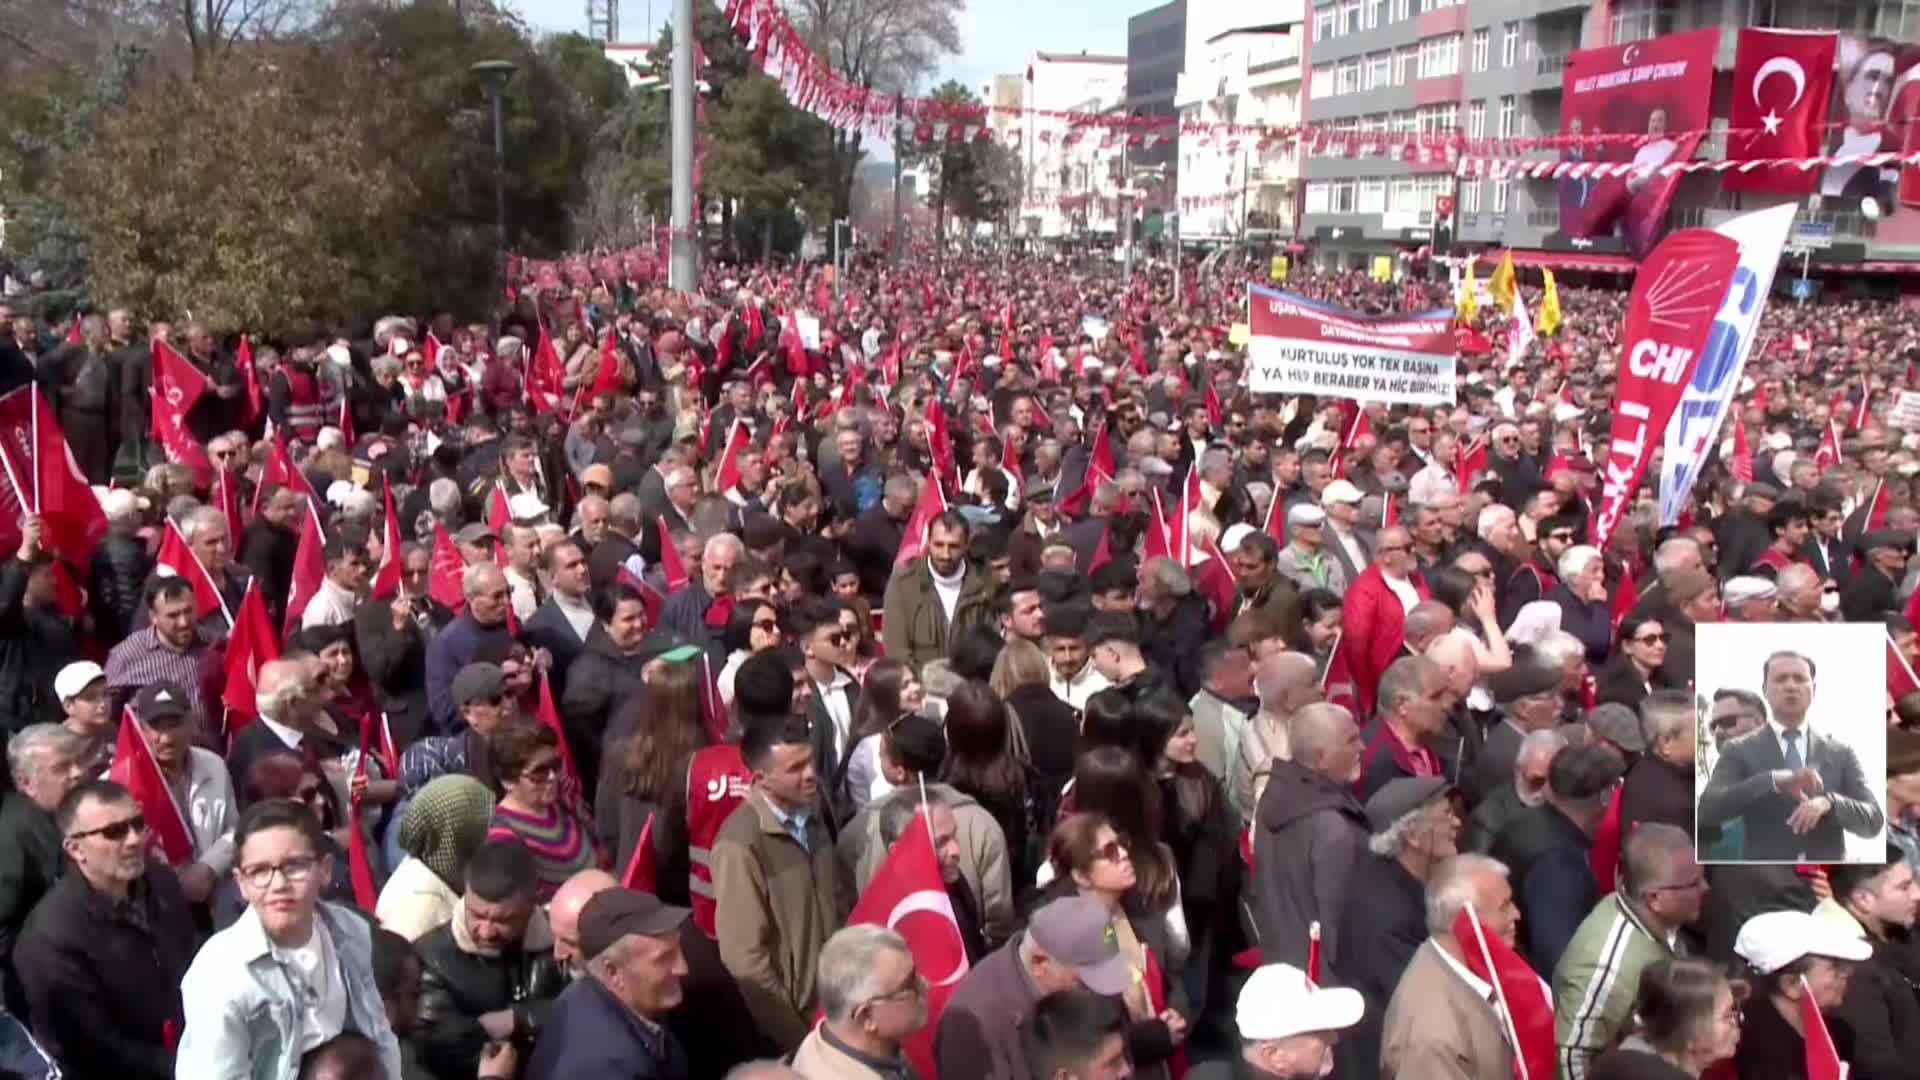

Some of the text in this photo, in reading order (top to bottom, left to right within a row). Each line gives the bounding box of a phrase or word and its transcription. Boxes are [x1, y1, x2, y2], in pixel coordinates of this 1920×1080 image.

[1280, 347, 1349, 369] KURTULUŞ
[1352, 353, 1375, 369] YOK
[1380, 356, 1399, 372] TEK
[1262, 367, 1282, 381] YA
[1313, 370, 1369, 389] BERABER
[1373, 376, 1387, 391] YA
[1389, 376, 1408, 394] HİÇ
